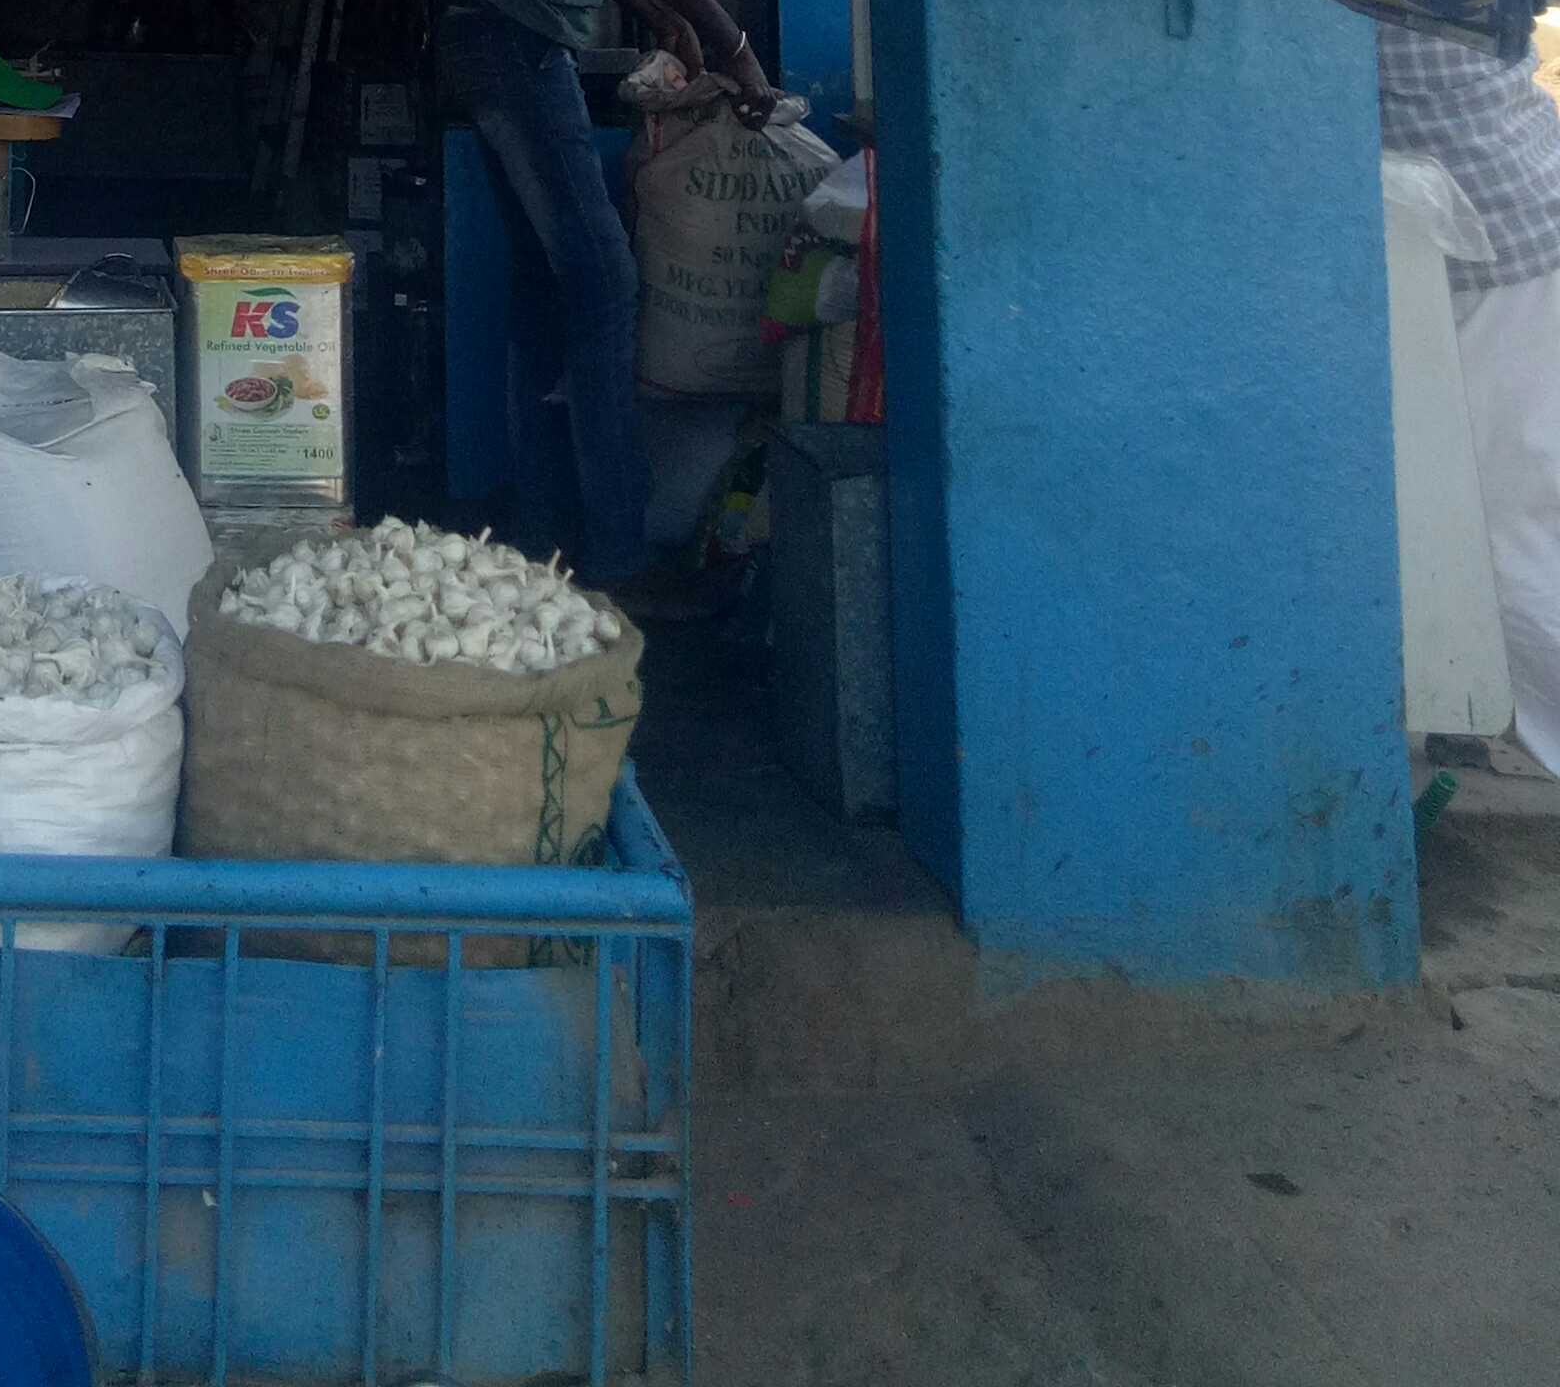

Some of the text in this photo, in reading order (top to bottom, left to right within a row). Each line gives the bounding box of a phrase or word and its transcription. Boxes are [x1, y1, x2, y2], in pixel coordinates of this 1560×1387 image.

[230, 301, 301, 339] KS
[205, 339, 336, 354] Refined Vegetable Oil
